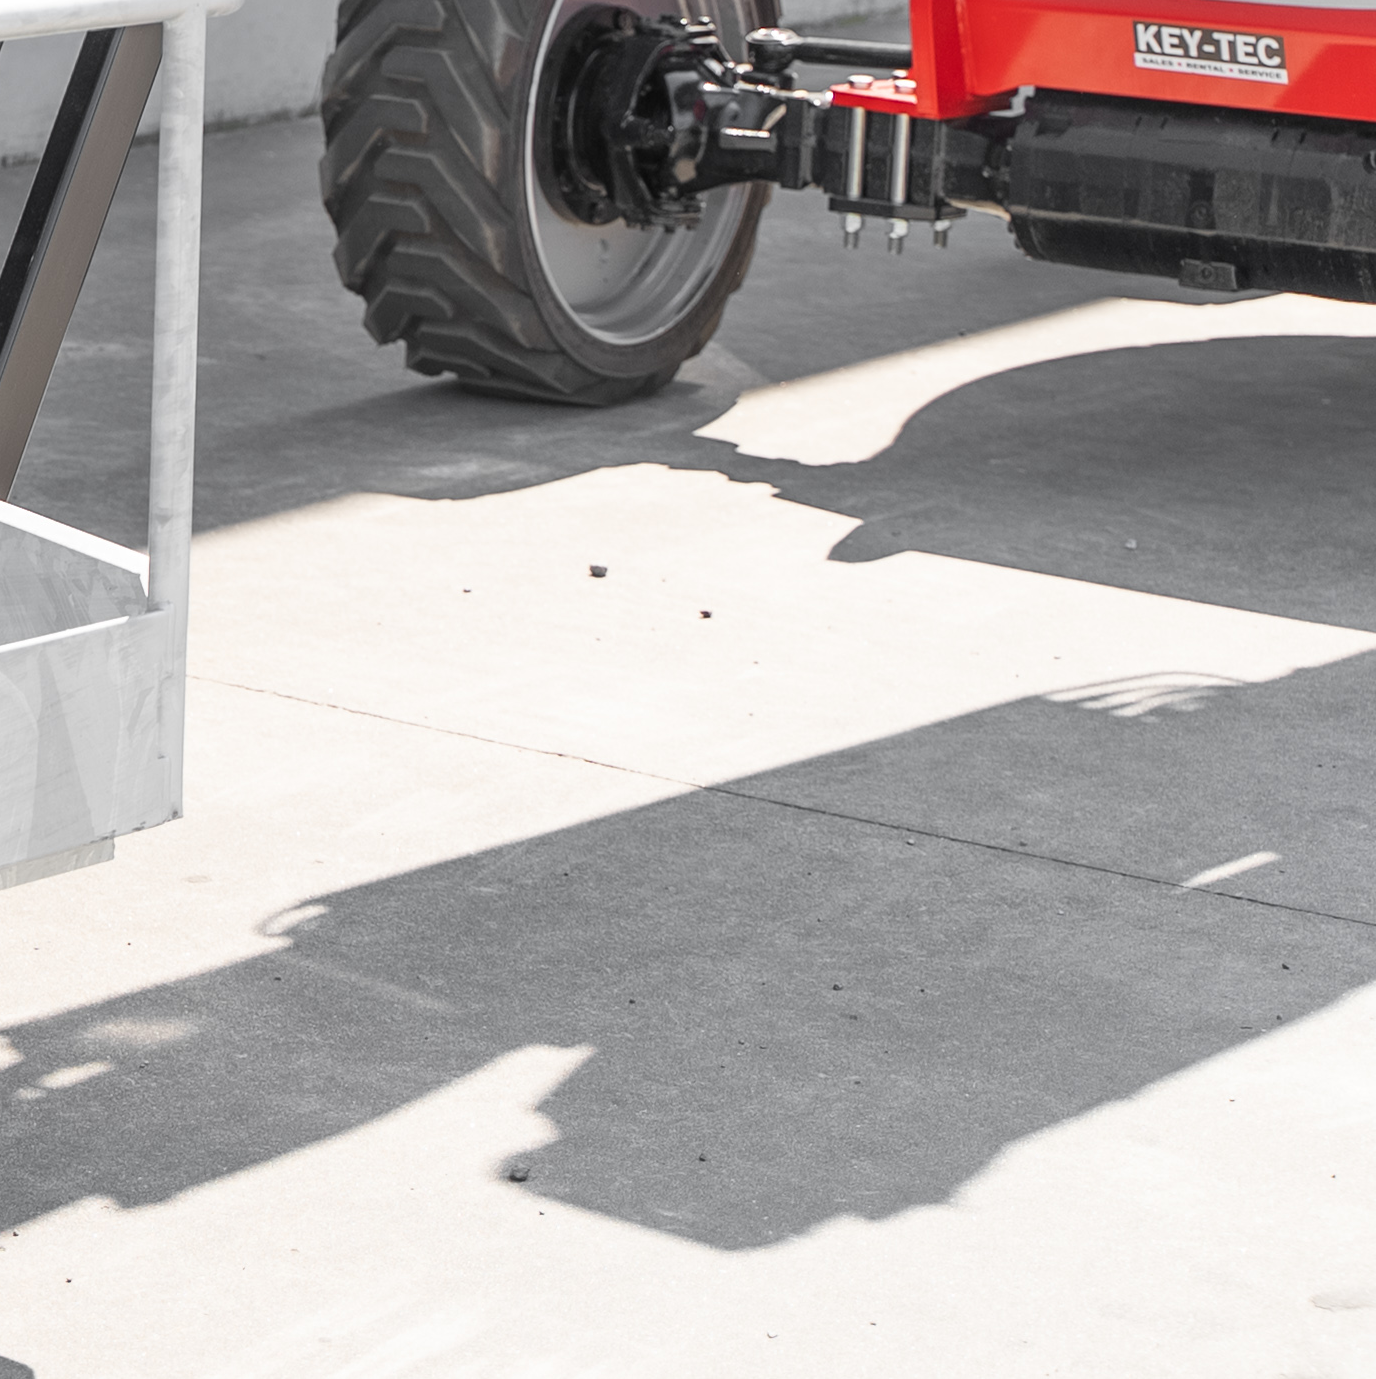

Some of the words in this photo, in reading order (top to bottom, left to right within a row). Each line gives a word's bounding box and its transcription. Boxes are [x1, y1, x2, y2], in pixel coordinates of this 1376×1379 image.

[1135, 23, 1282, 67] KEY-TEC
[1142, 57, 1174, 67] SALES
[1186, 62, 1224, 73] RENTAL
[1238, 68, 1282, 79] SERVICE
